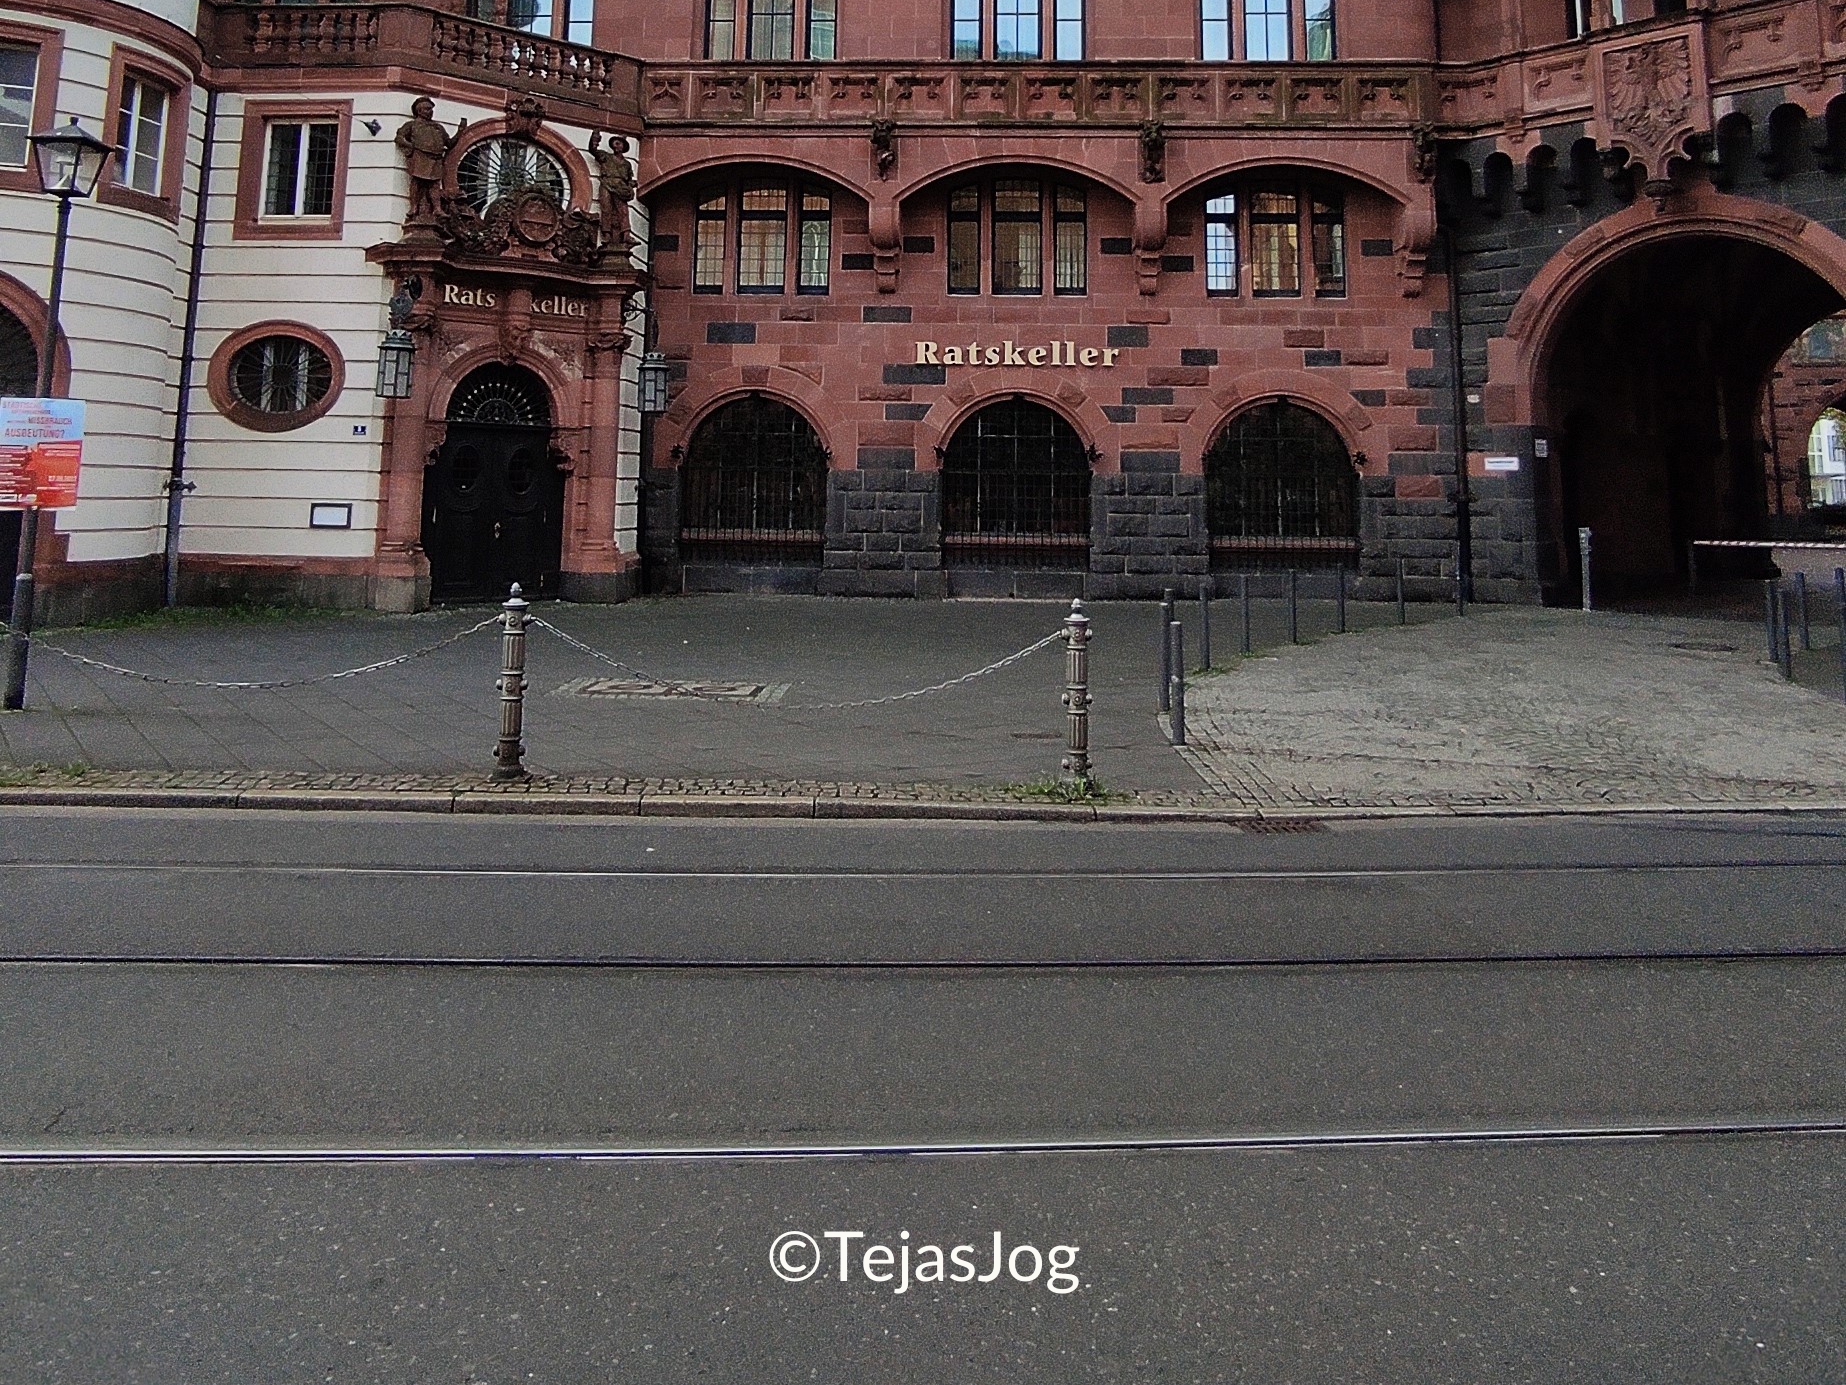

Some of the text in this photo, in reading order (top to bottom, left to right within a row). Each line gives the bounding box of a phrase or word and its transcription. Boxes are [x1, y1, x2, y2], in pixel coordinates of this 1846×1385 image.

[443, 283, 496, 308] Rats
[915, 340, 1120, 367] Ratskeller
[4, 427, 66, 439] AUSBEUTUNG?
